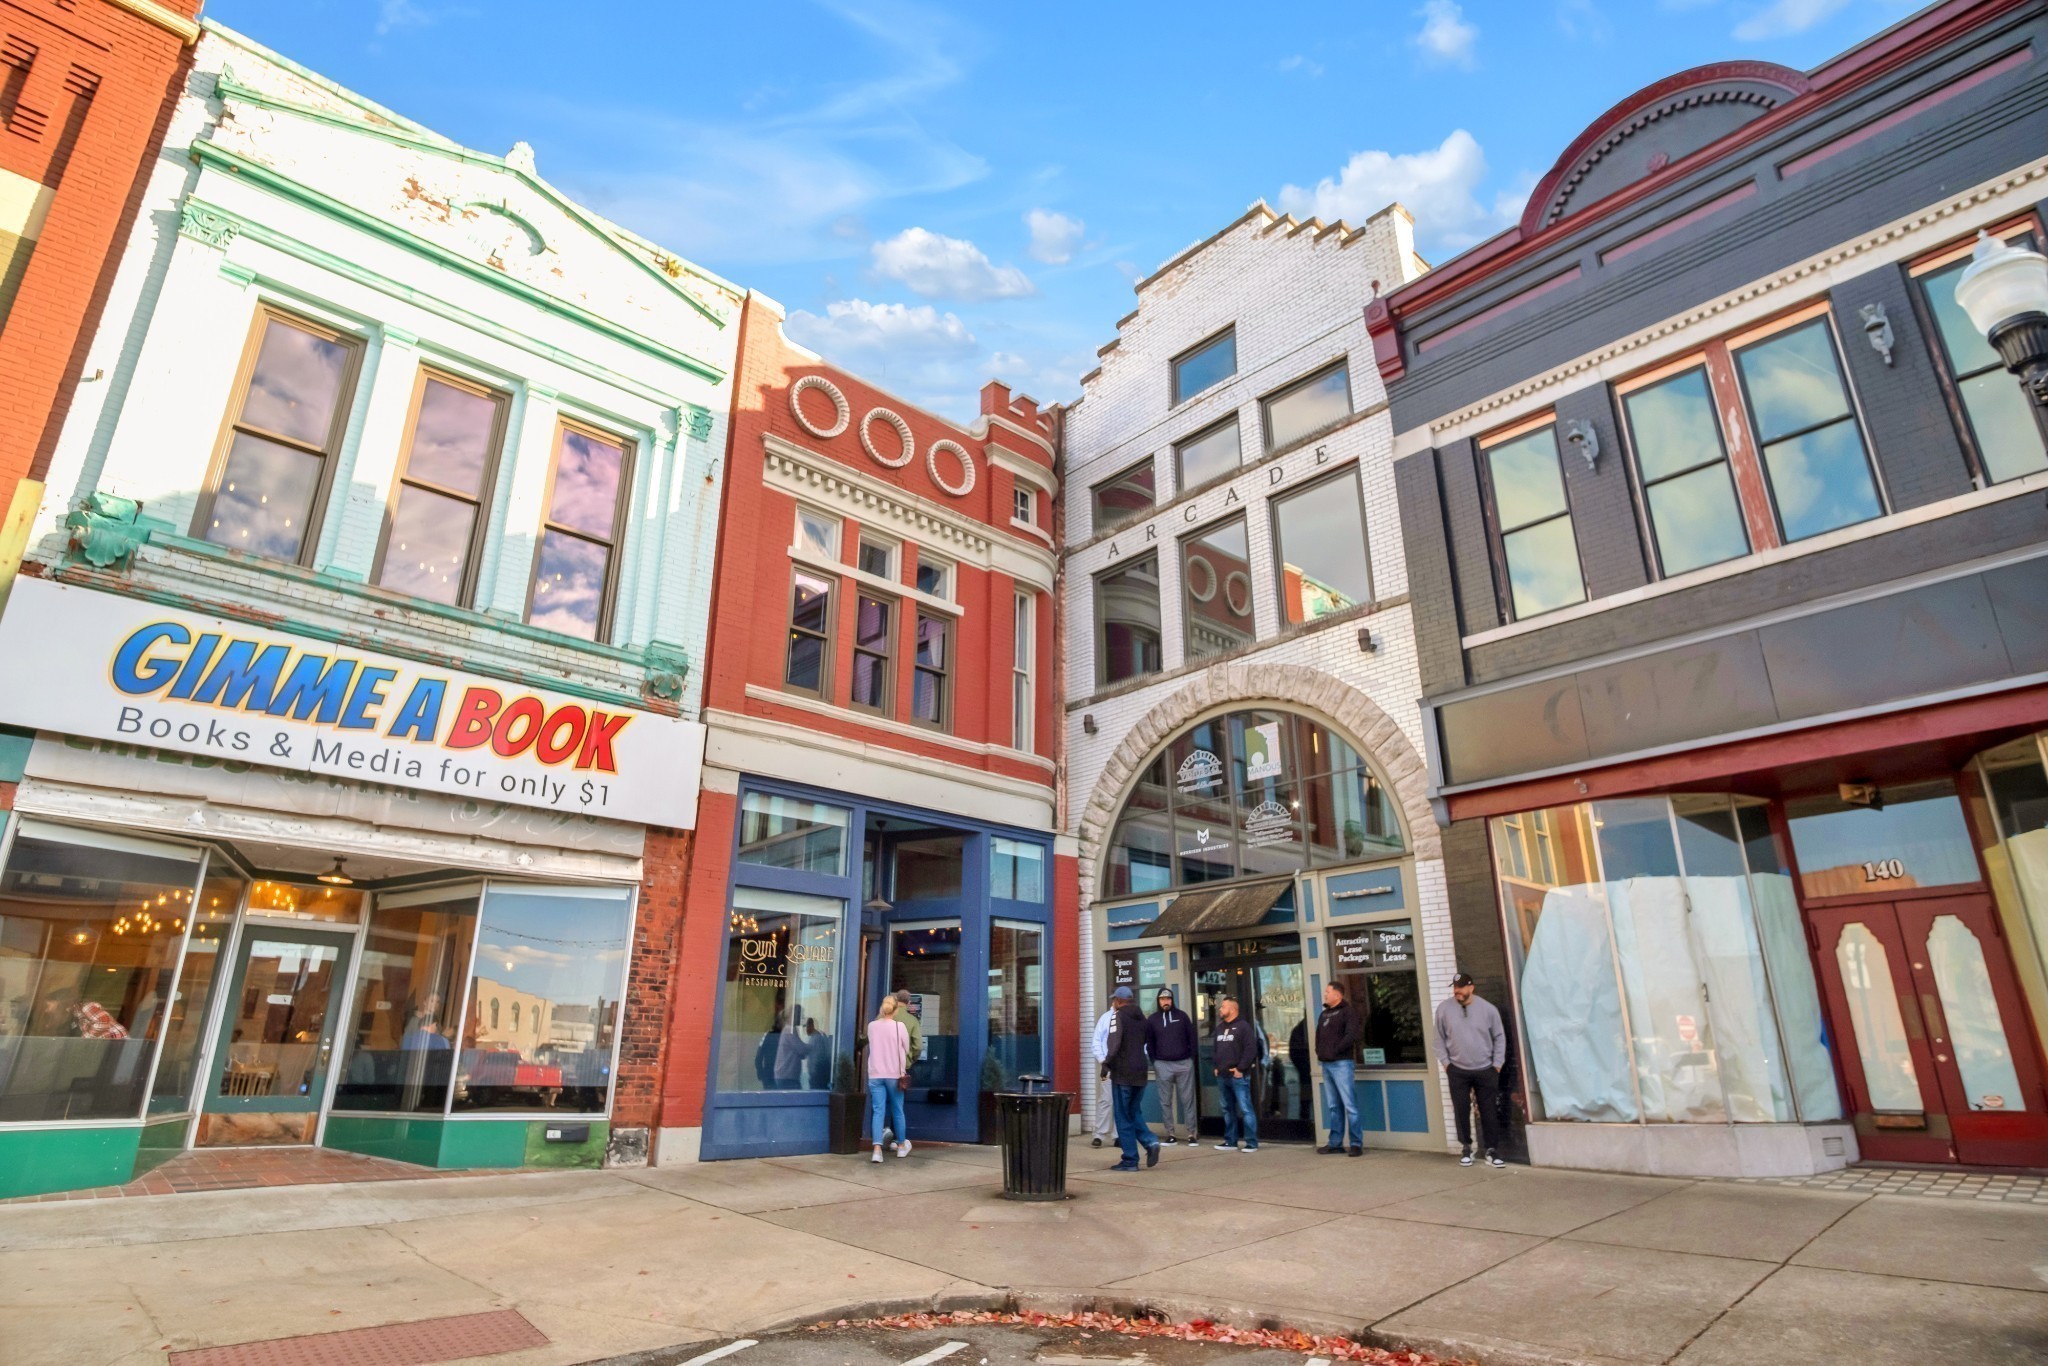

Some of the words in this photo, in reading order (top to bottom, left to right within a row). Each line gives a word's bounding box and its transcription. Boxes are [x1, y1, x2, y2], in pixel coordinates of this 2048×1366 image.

[1107, 444, 1329, 560] ARCADE
[110, 619, 400, 730] GIMME
[386, 676, 449, 743] A
[443, 685, 635, 774] BOOK
[116, 706, 251, 751] Books
[269, 732, 293, 758] &
[312, 738, 422, 778] Media
[439, 758, 487, 788] for
[500, 774, 566, 804] only
[579, 779, 609, 806] $1
[1862, 858, 1904, 882] 140
[1336, 937, 1369, 947] Attractive
[1380, 933, 1406, 944] Space
[741, 938, 778, 961] TOWN
[785, 943, 834, 964] SQUARE
[1237, 941, 1258, 955] 142
[1343, 946, 1362, 954] Lease
[1386, 944, 1401, 953] For
[1338, 954, 1370, 963] Packages
[1382, 953, 1407, 962] Lease
[1114, 959, 1133, 968] Space
[1118, 968, 1130, 976] For
